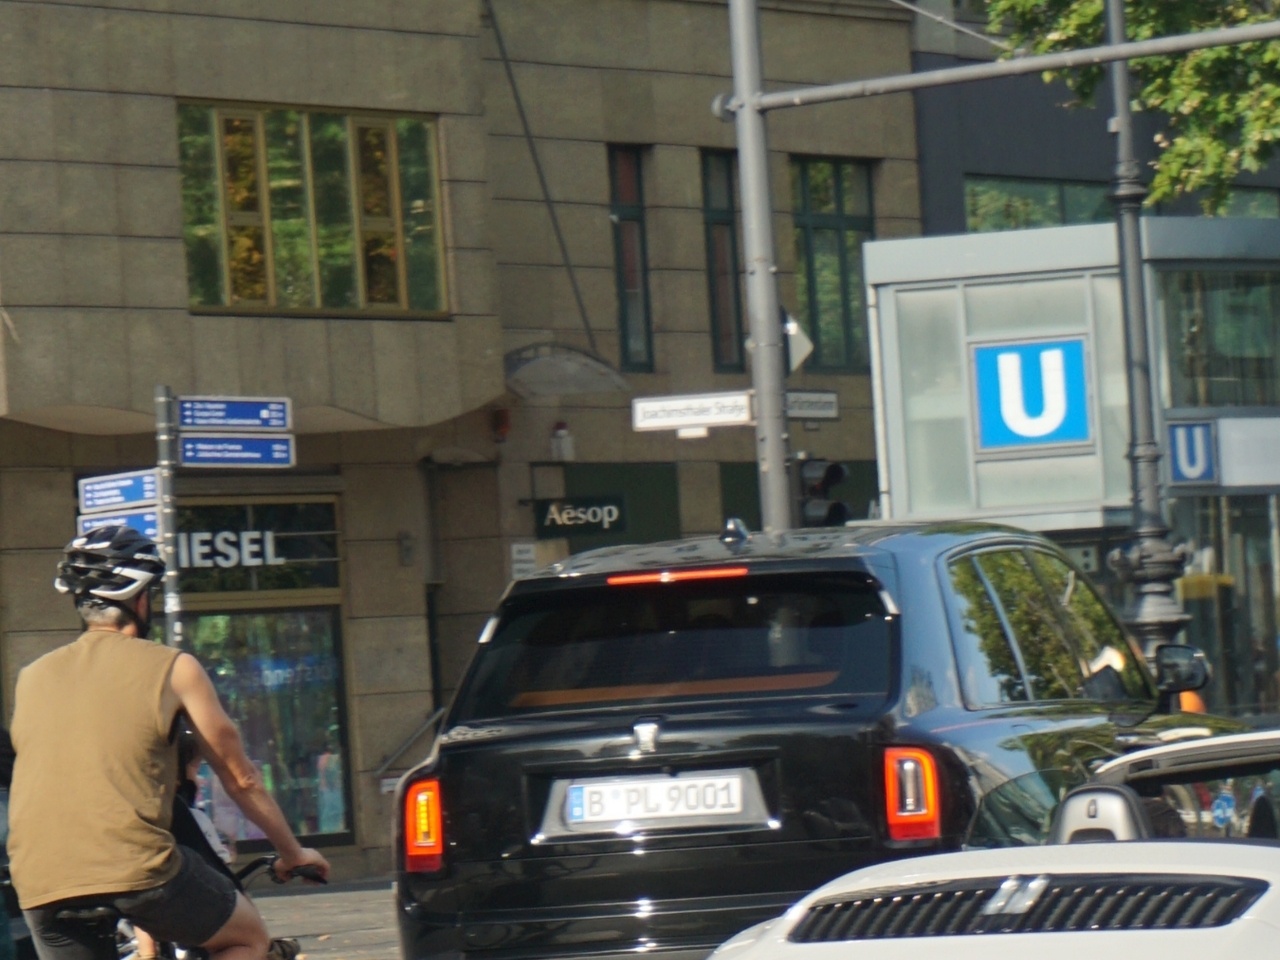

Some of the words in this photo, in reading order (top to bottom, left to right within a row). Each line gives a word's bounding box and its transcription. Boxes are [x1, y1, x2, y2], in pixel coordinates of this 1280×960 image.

[997, 348, 1067, 438] U
[1175, 426, 1209, 479] U
[177, 531, 287, 568] IESEL
[588, 790, 605, 817] B
[625, 786, 660, 815] PL
[667, 781, 736, 812] 9001
